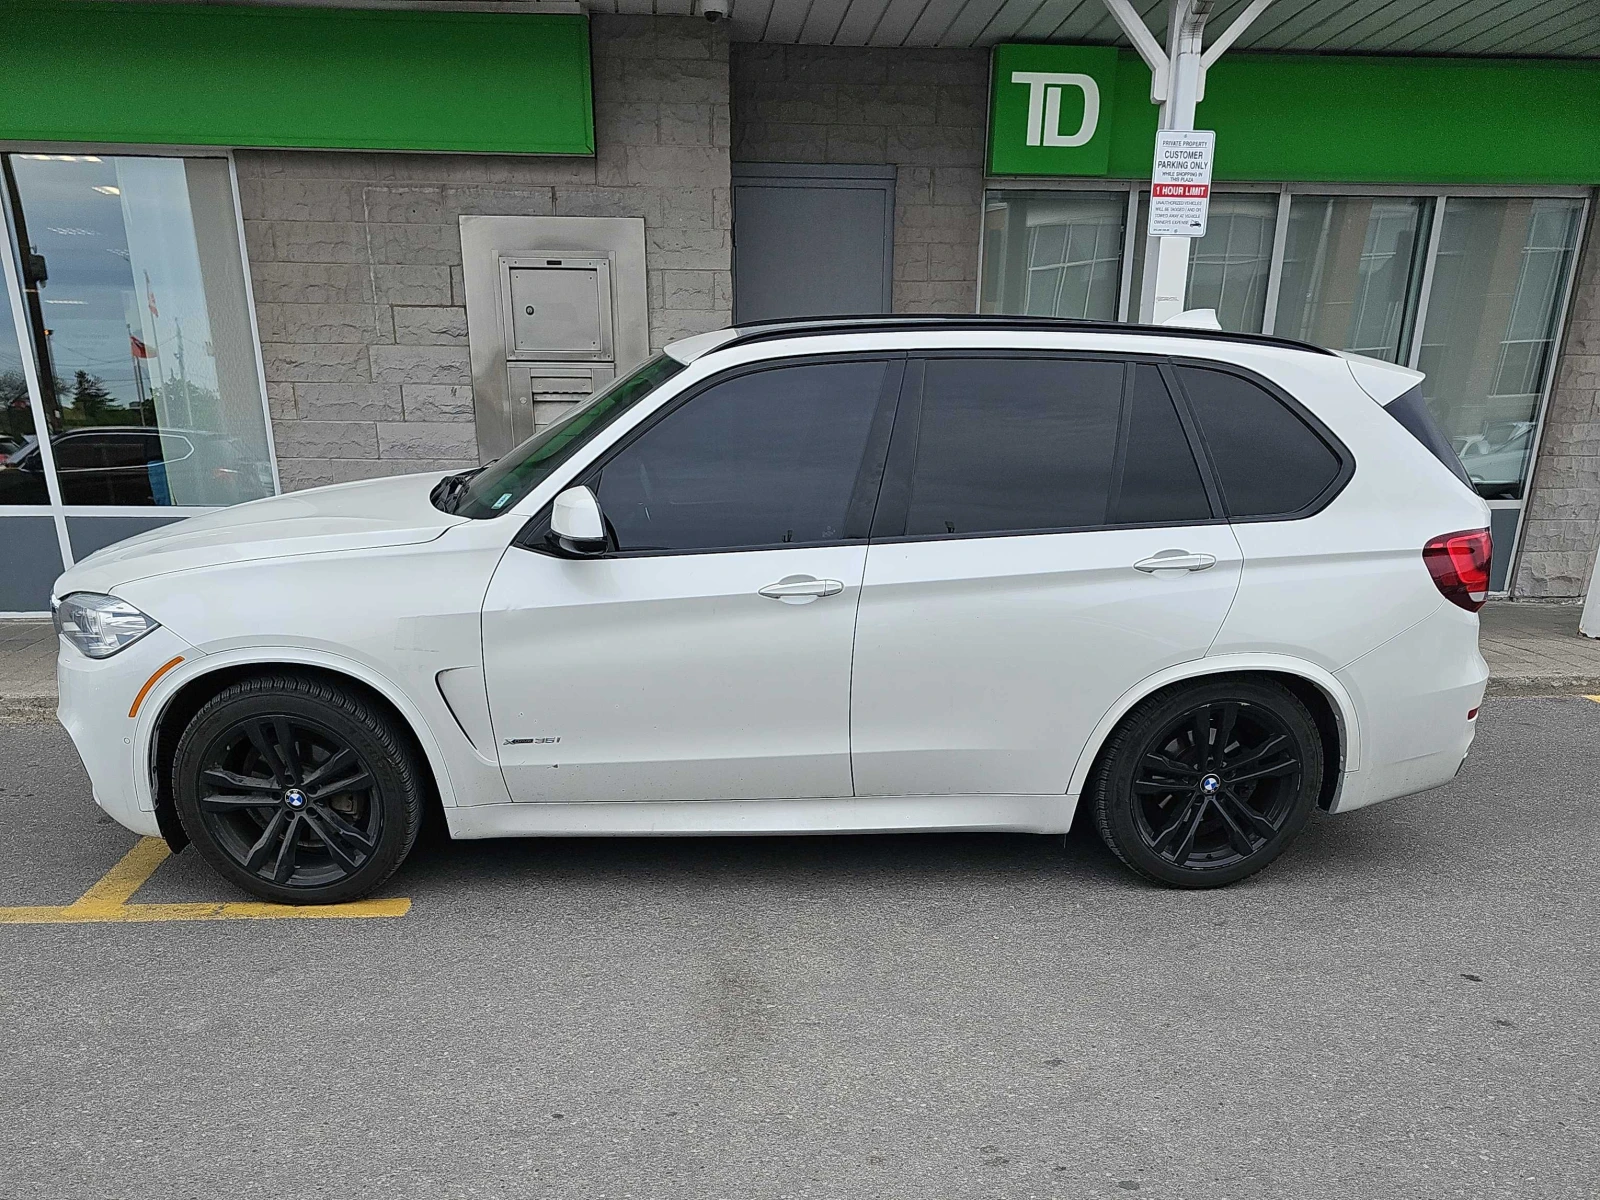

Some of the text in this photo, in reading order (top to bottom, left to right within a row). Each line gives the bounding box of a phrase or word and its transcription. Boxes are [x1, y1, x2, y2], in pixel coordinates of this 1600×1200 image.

[1011, 71, 1100, 147] TD
[1164, 150, 1203, 159] CUSTOMER
[1157, 161, 1208, 170] PARKING ONLY
[1156, 186, 1206, 196] 1 HOUR LIMIT
